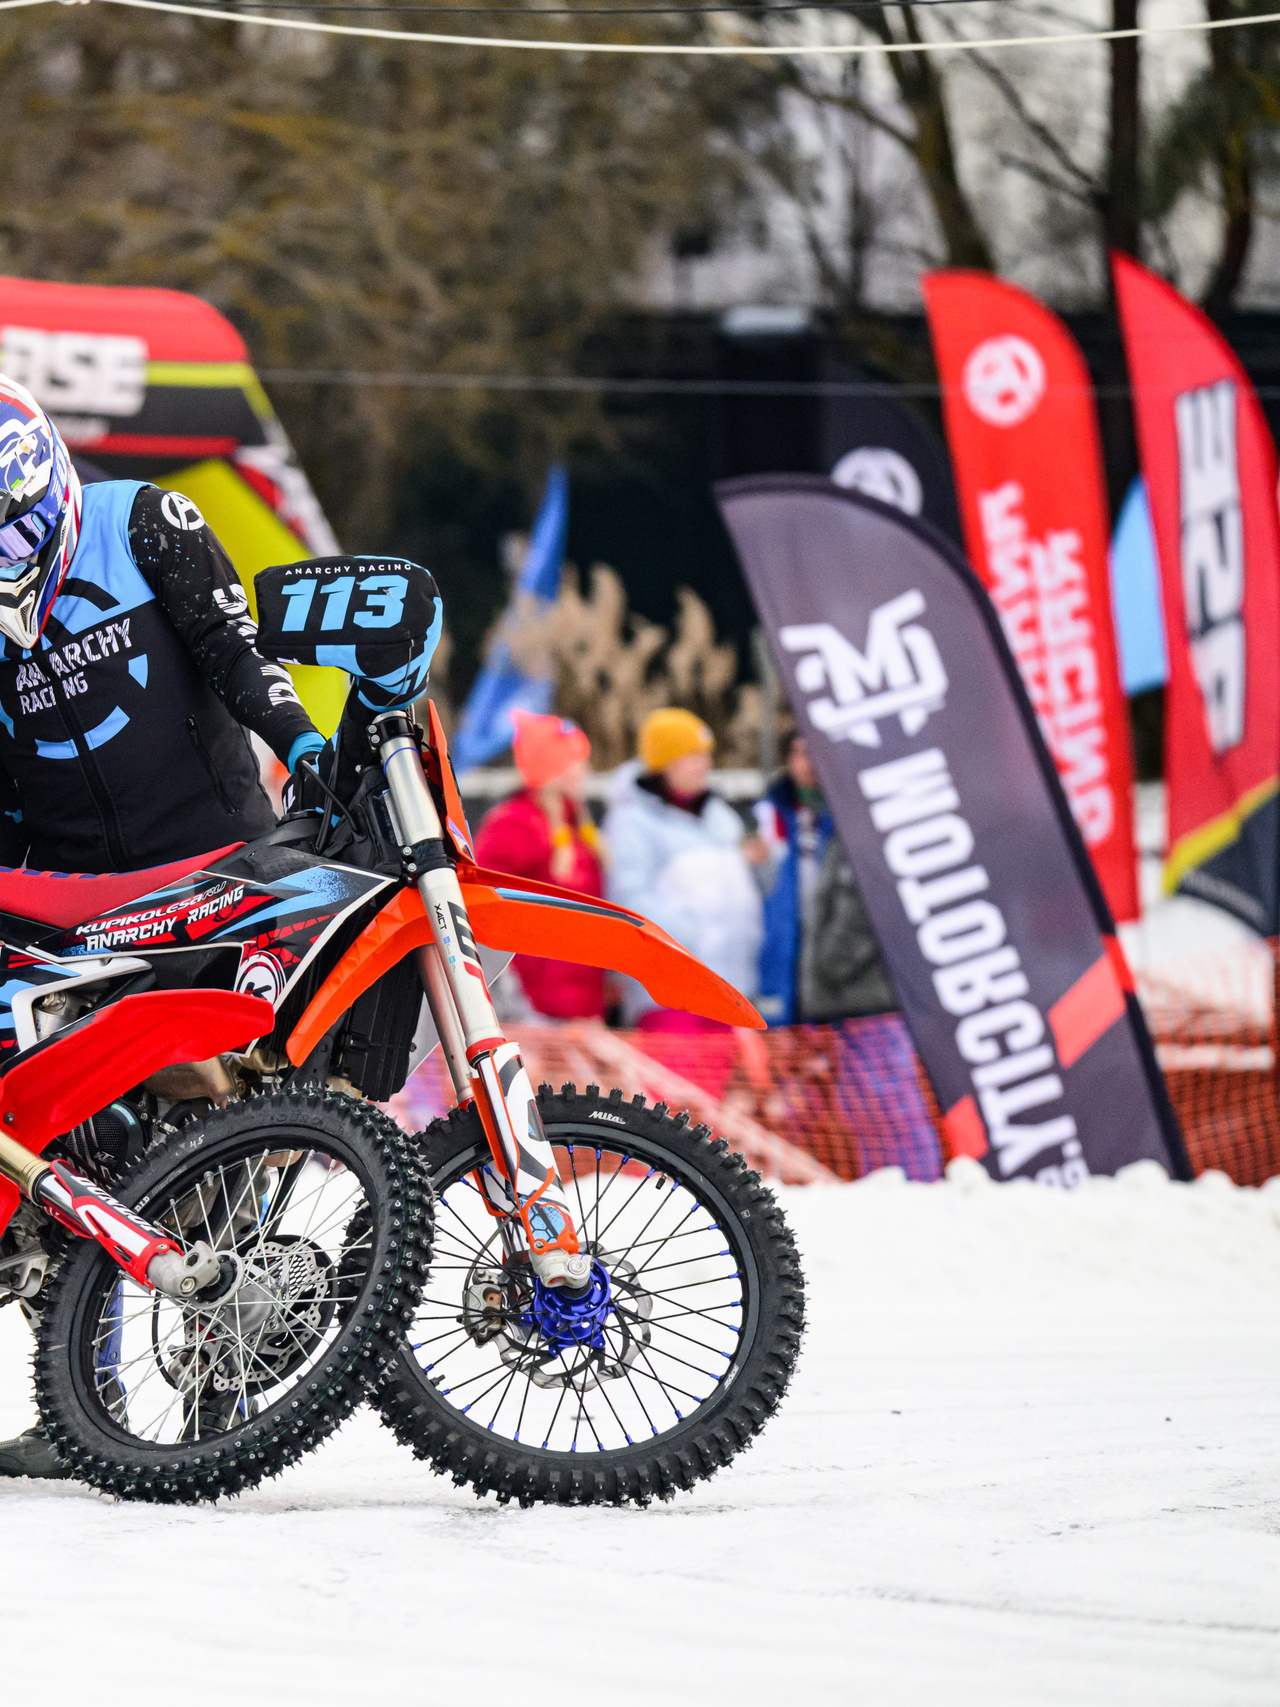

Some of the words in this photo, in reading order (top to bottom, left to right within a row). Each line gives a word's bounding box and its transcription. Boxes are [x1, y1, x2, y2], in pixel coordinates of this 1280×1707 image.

[285, 565, 351, 576] ANARCHY
[359, 563, 412, 573] RACING
[281, 574, 409, 632] 113
[15, 617, 132, 692] ANARCHY
[19, 671, 89, 715] RACING
[85, 916, 178, 951] ANARCHY
[187, 884, 246, 926] RACING
[434, 903, 447, 930] XACT
